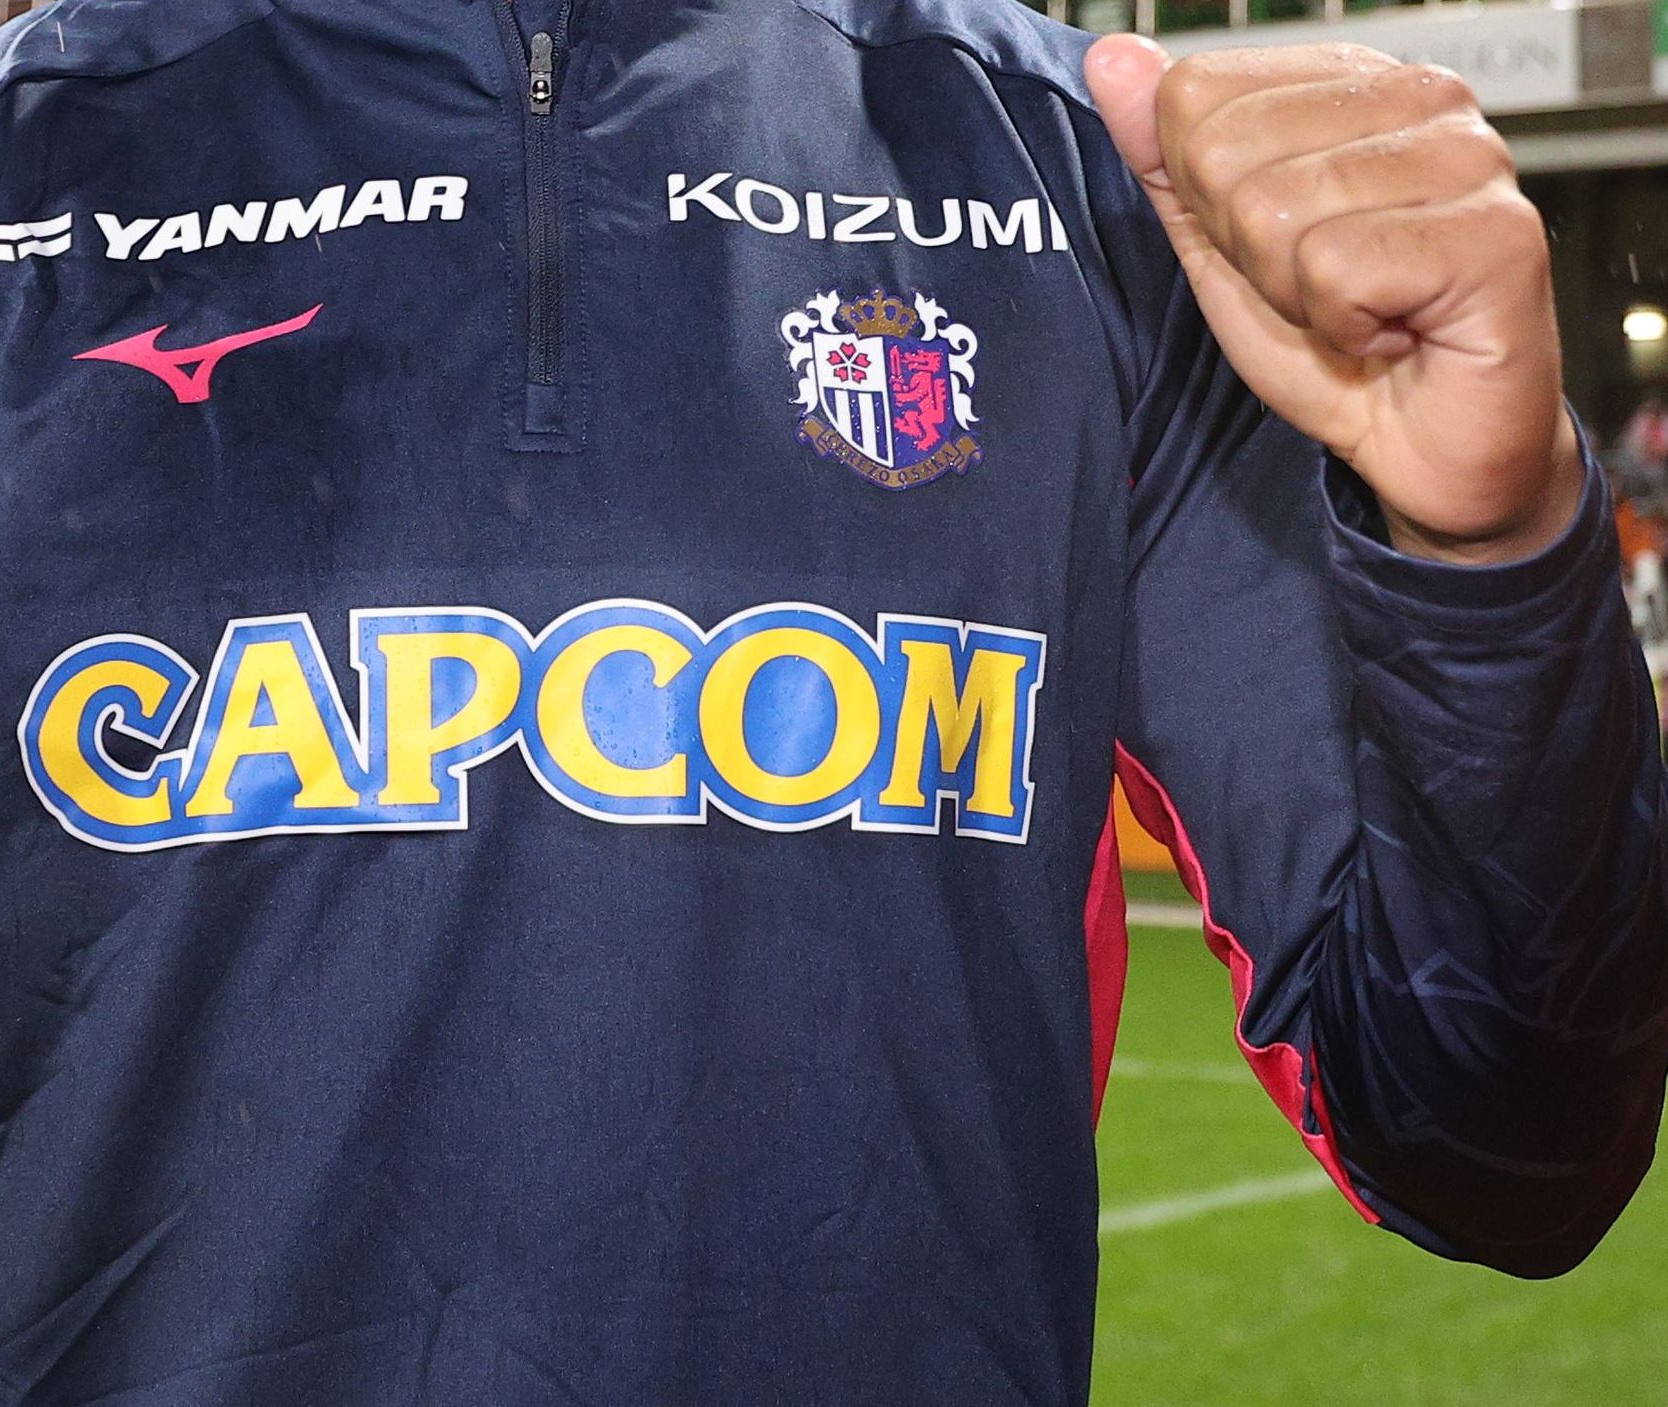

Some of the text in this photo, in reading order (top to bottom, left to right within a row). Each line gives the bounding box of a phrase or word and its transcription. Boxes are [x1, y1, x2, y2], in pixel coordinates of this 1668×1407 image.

[94, 175, 468, 260] YANMAR
[897, 448, 955, 484] OSAKA
[17, 598, 1048, 851] CAPCOM
